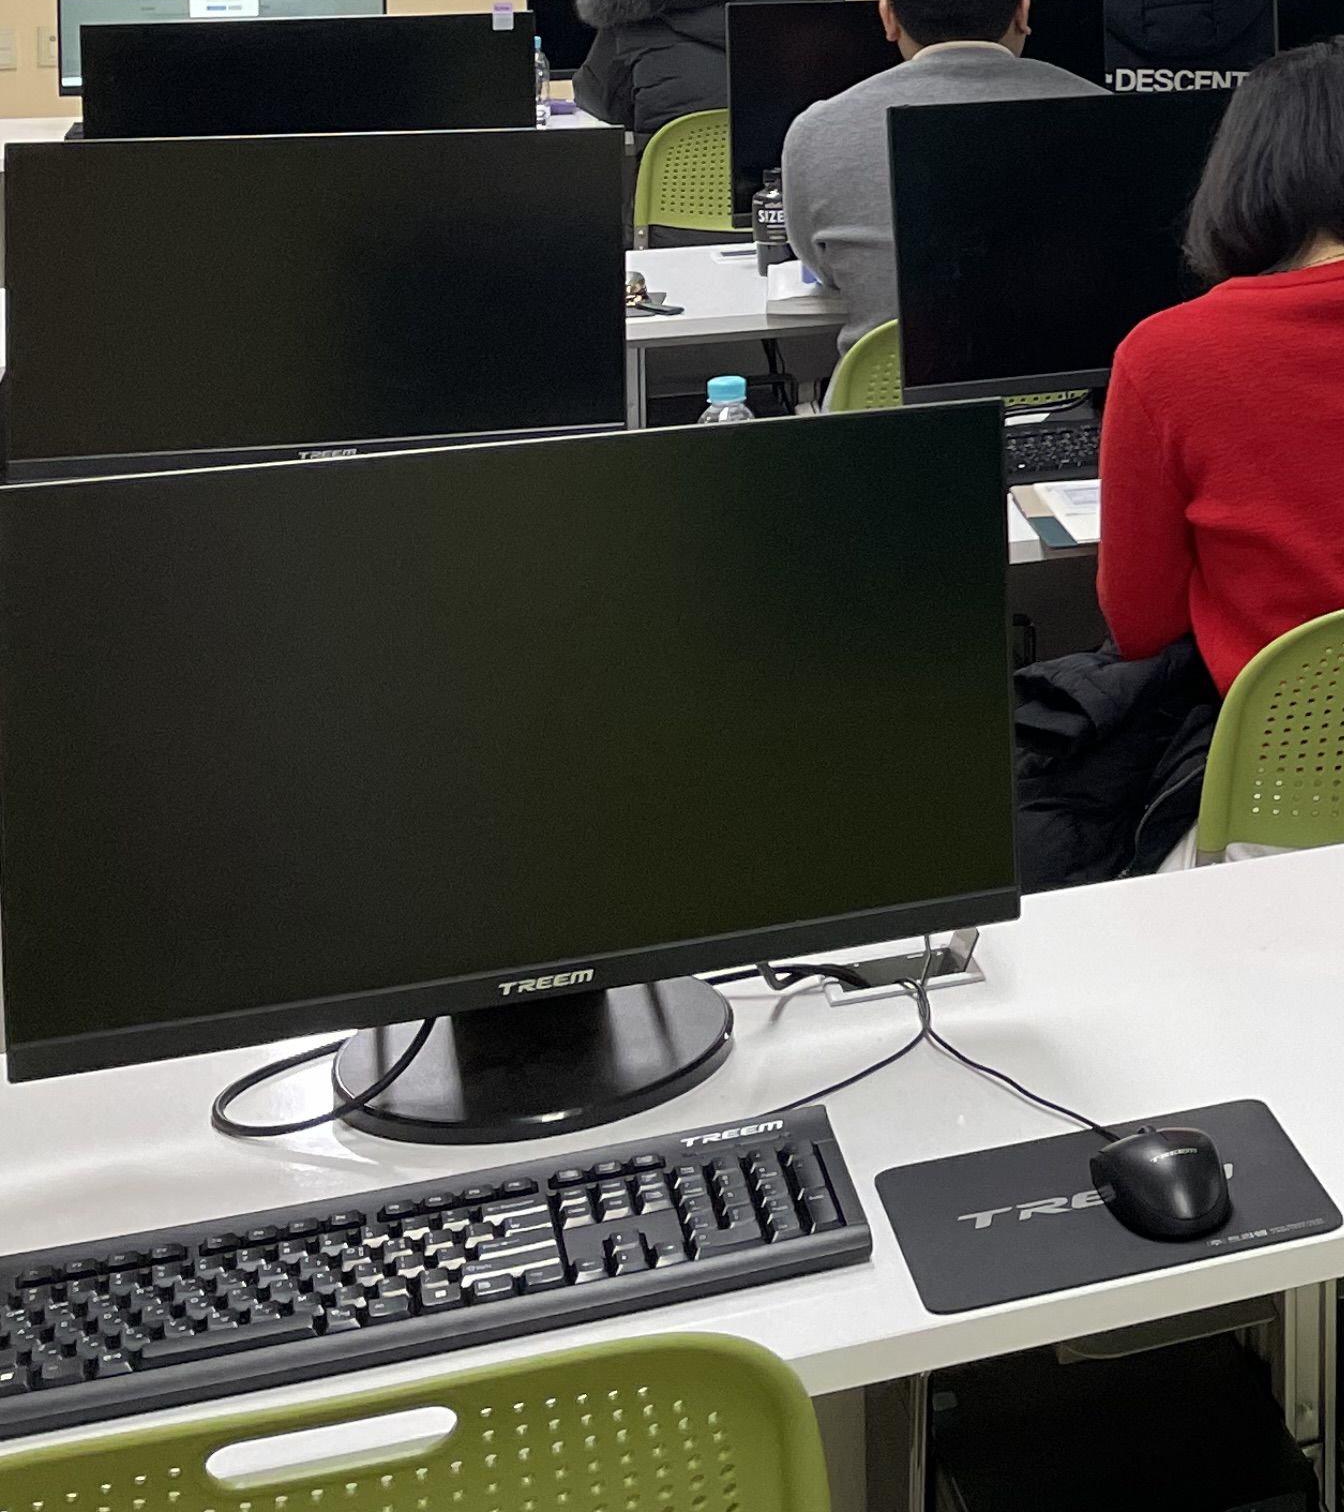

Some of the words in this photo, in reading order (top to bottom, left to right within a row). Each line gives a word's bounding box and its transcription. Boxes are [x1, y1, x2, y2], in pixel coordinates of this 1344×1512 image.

[1115, 69, 1250, 92] DESCENT
[758, 210, 785, 223] SIZE
[499, 969, 594, 996] TREEM
[680, 1120, 784, 1148] TREEM
